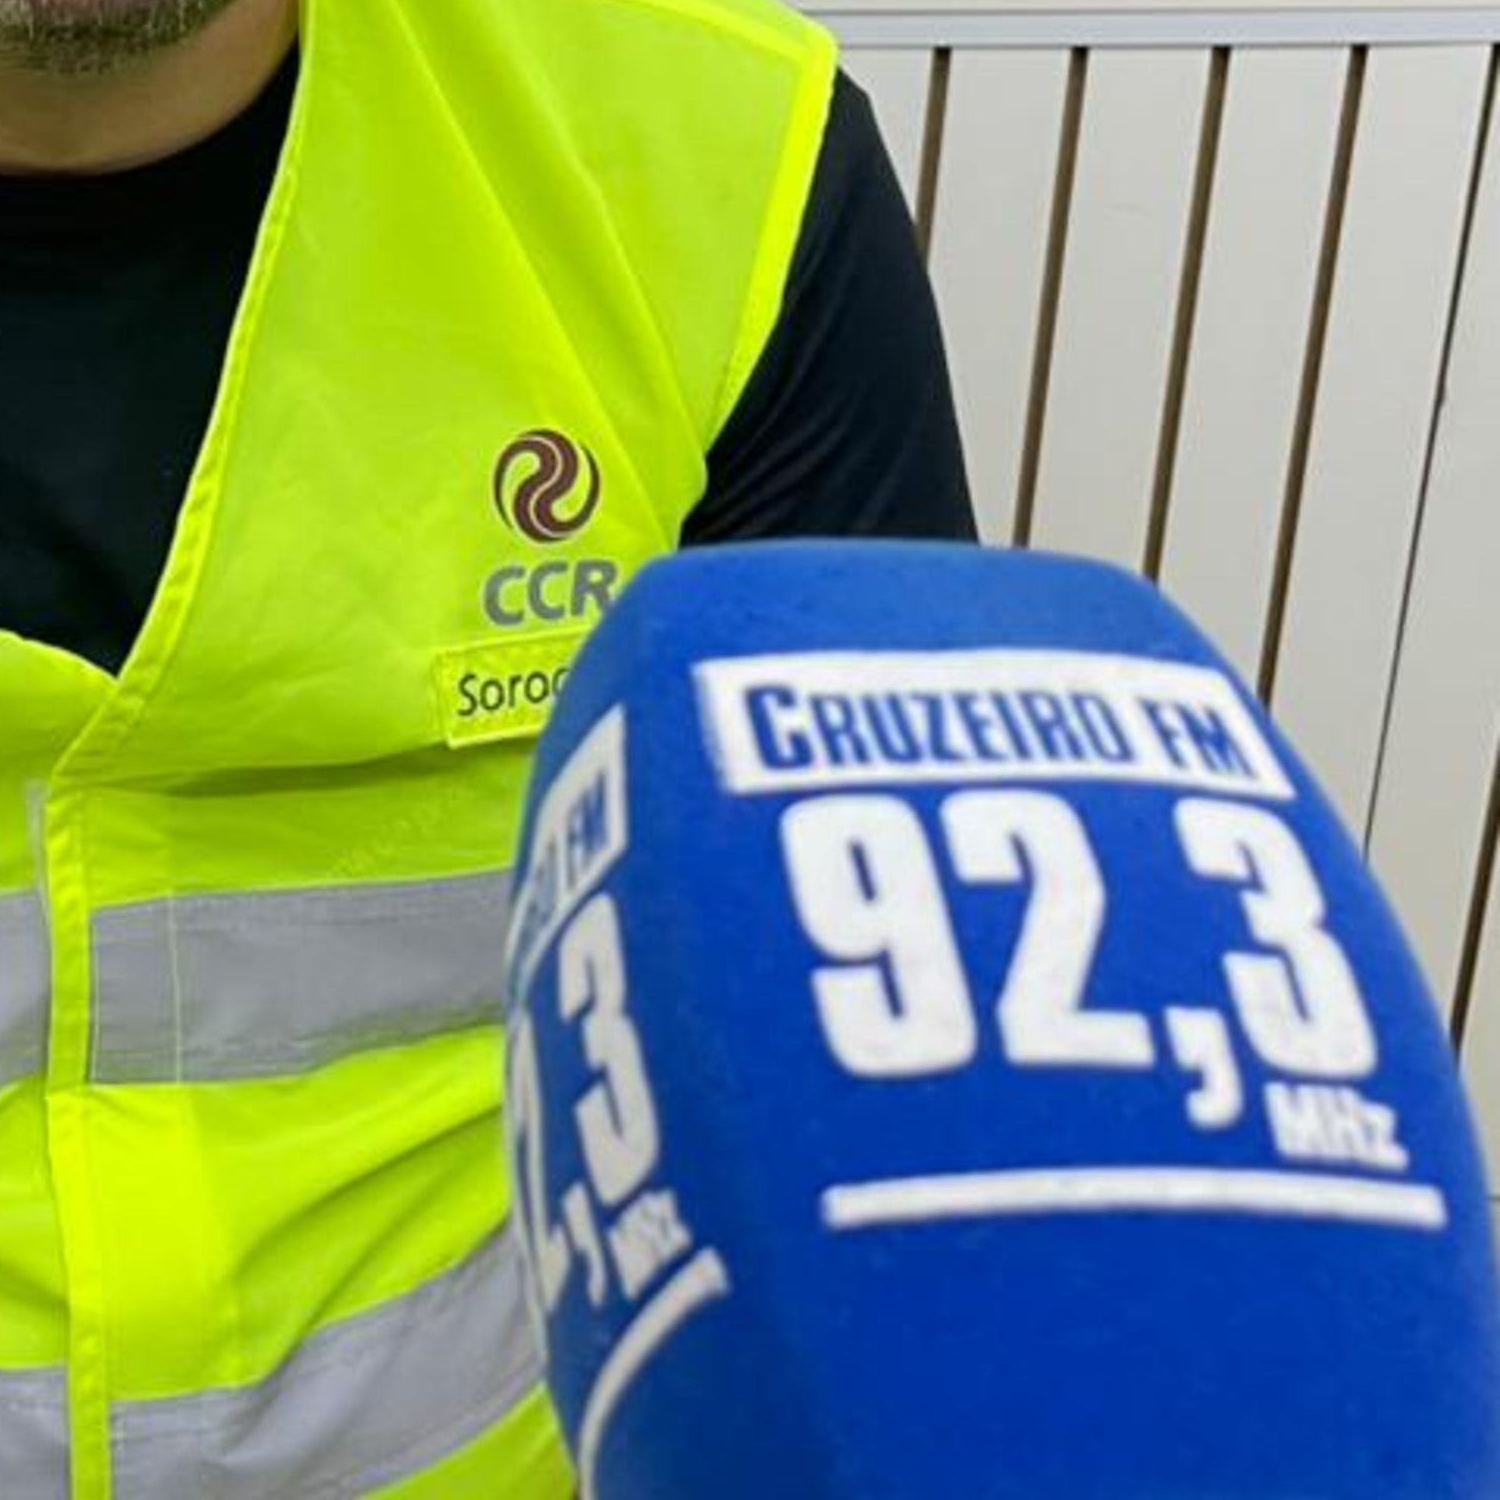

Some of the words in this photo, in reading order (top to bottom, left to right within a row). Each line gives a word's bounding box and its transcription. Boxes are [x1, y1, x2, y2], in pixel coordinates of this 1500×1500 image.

[483, 559, 619, 626] CCR
[745, 686, 1136, 771] CRUZEIRO
[1141, 697, 1259, 780] FM
[779, 788, 1378, 1130] 92,3
[1264, 1081, 1409, 1170] MHz
